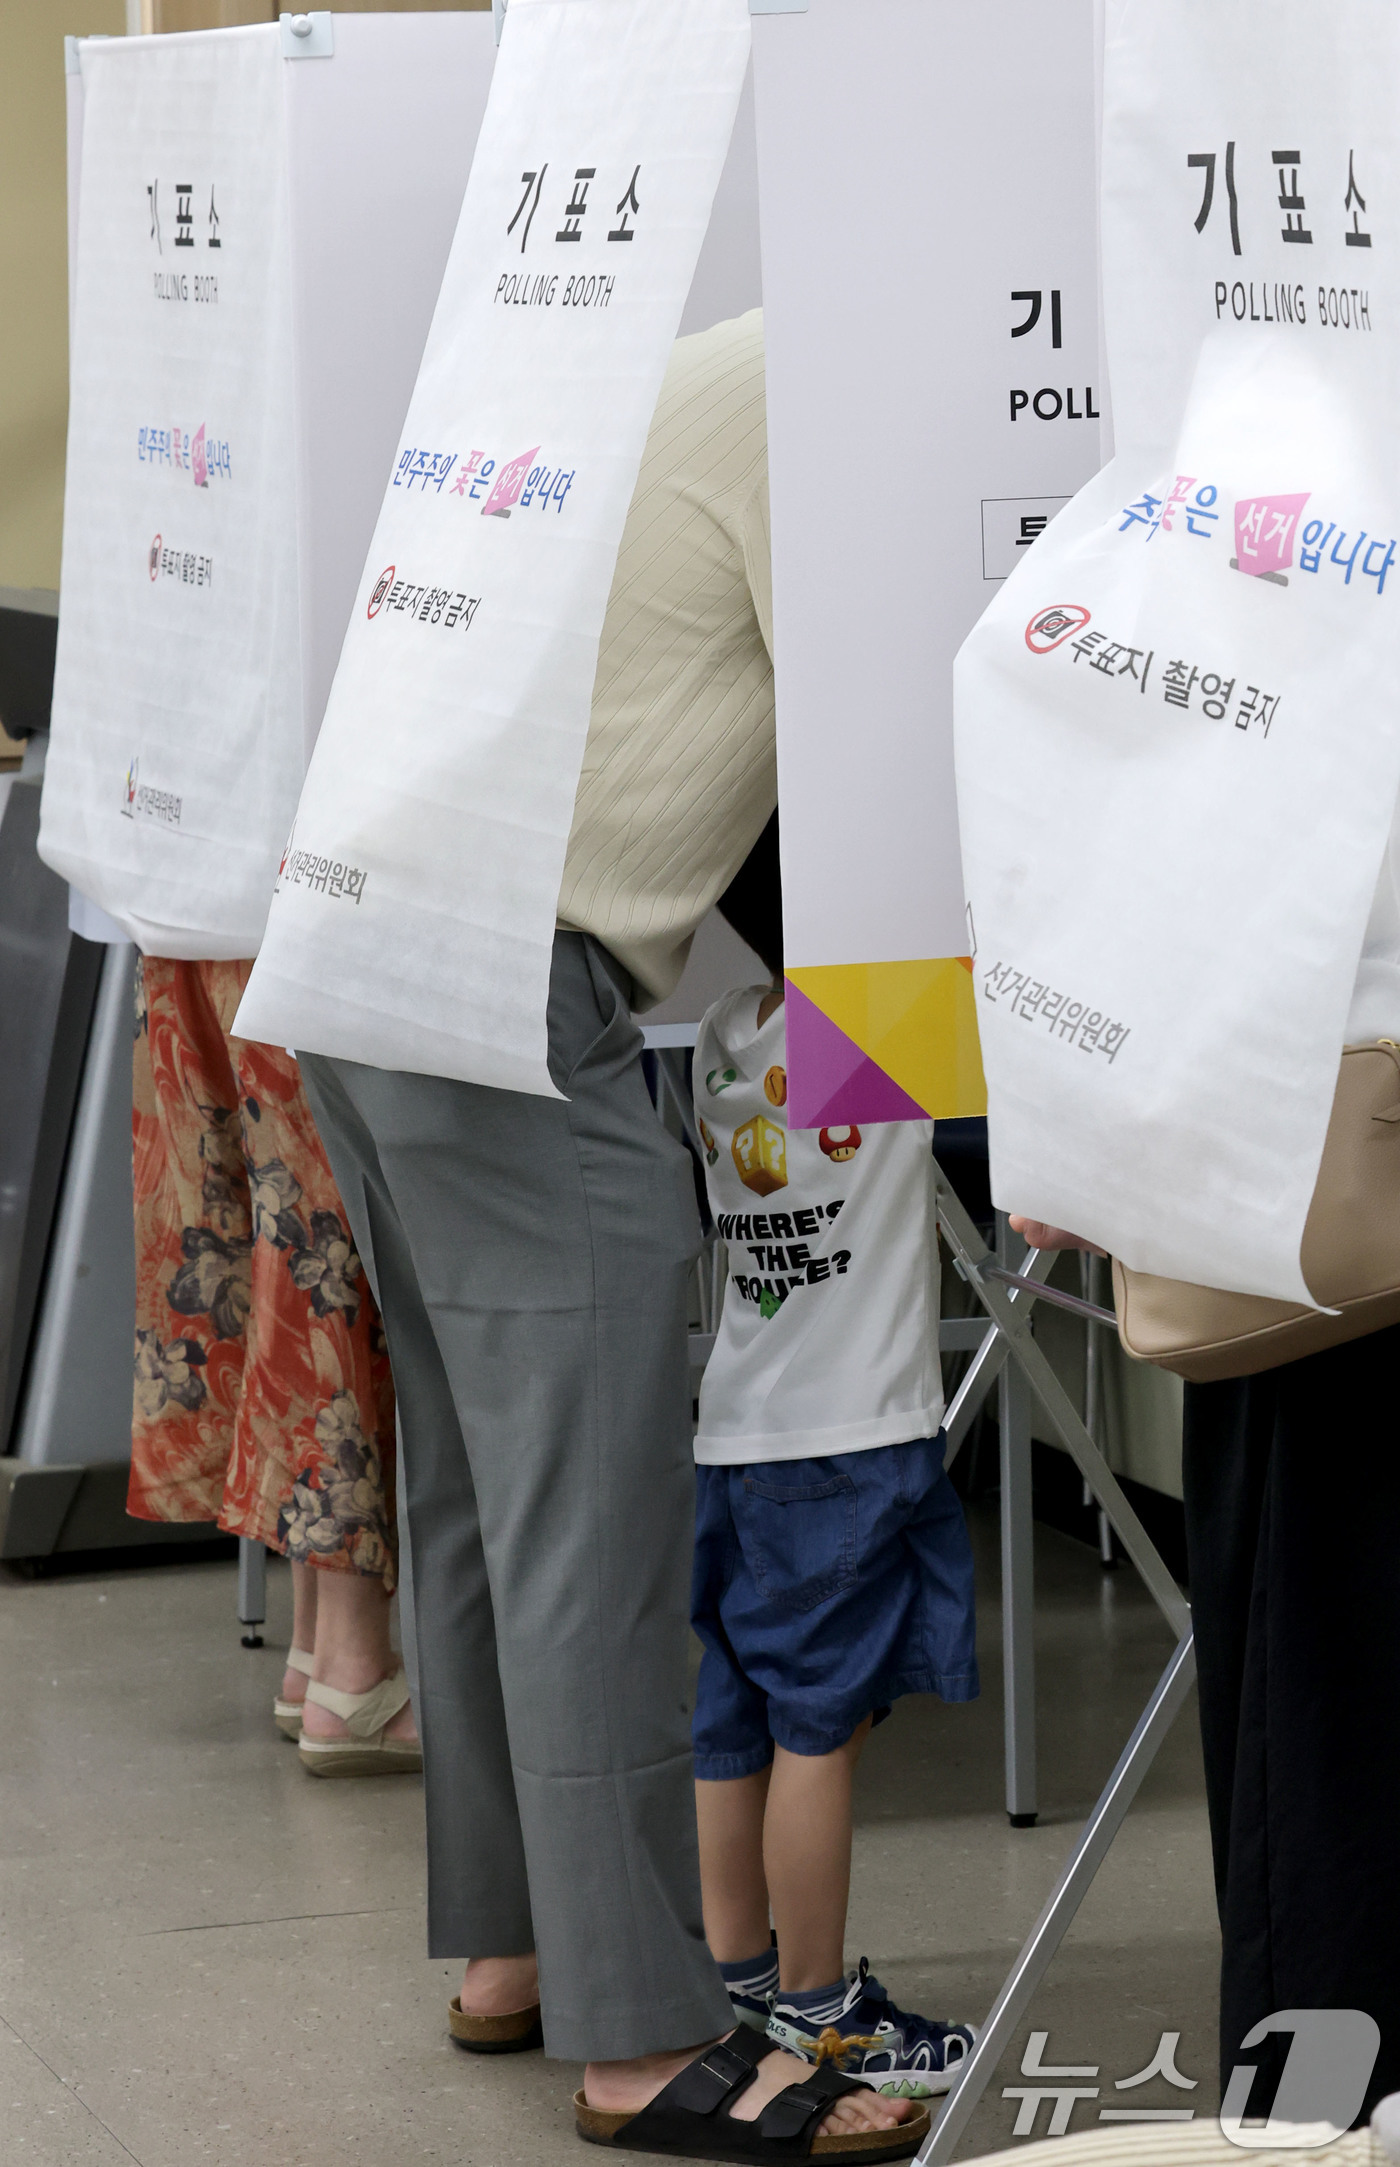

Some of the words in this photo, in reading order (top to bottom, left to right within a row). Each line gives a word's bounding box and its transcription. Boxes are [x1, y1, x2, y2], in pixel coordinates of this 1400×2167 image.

[147, 178, 221, 255] 기표소
[507, 163, 642, 254] 기표소
[1188, 141, 1372, 256] 기표소
[494, 273, 559, 307] POLLING
[562, 275, 616, 307] BOOTH
[1215, 281, 1306, 324] POLLING
[1318, 286, 1371, 332] BOOTH
[1010, 386, 1100, 422] POLL
[393, 448, 458, 494] 민주주의
[449, 449, 496, 499] 꽃은
[490, 462, 576, 514] 선거입니다
[1239, 502, 1397, 595] 선거입니다
[386, 580, 429, 618] 투표지
[418, 586, 453, 624] 촬영
[444, 593, 482, 631] 금지
[1070, 631, 1154, 694] 투표지
[1162, 659, 1236, 720] 촬영
[1235, 686, 1282, 739] 금지
[984, 961, 1132, 1065] 선거관리위원회
[747, 1243, 811, 1271] THE
